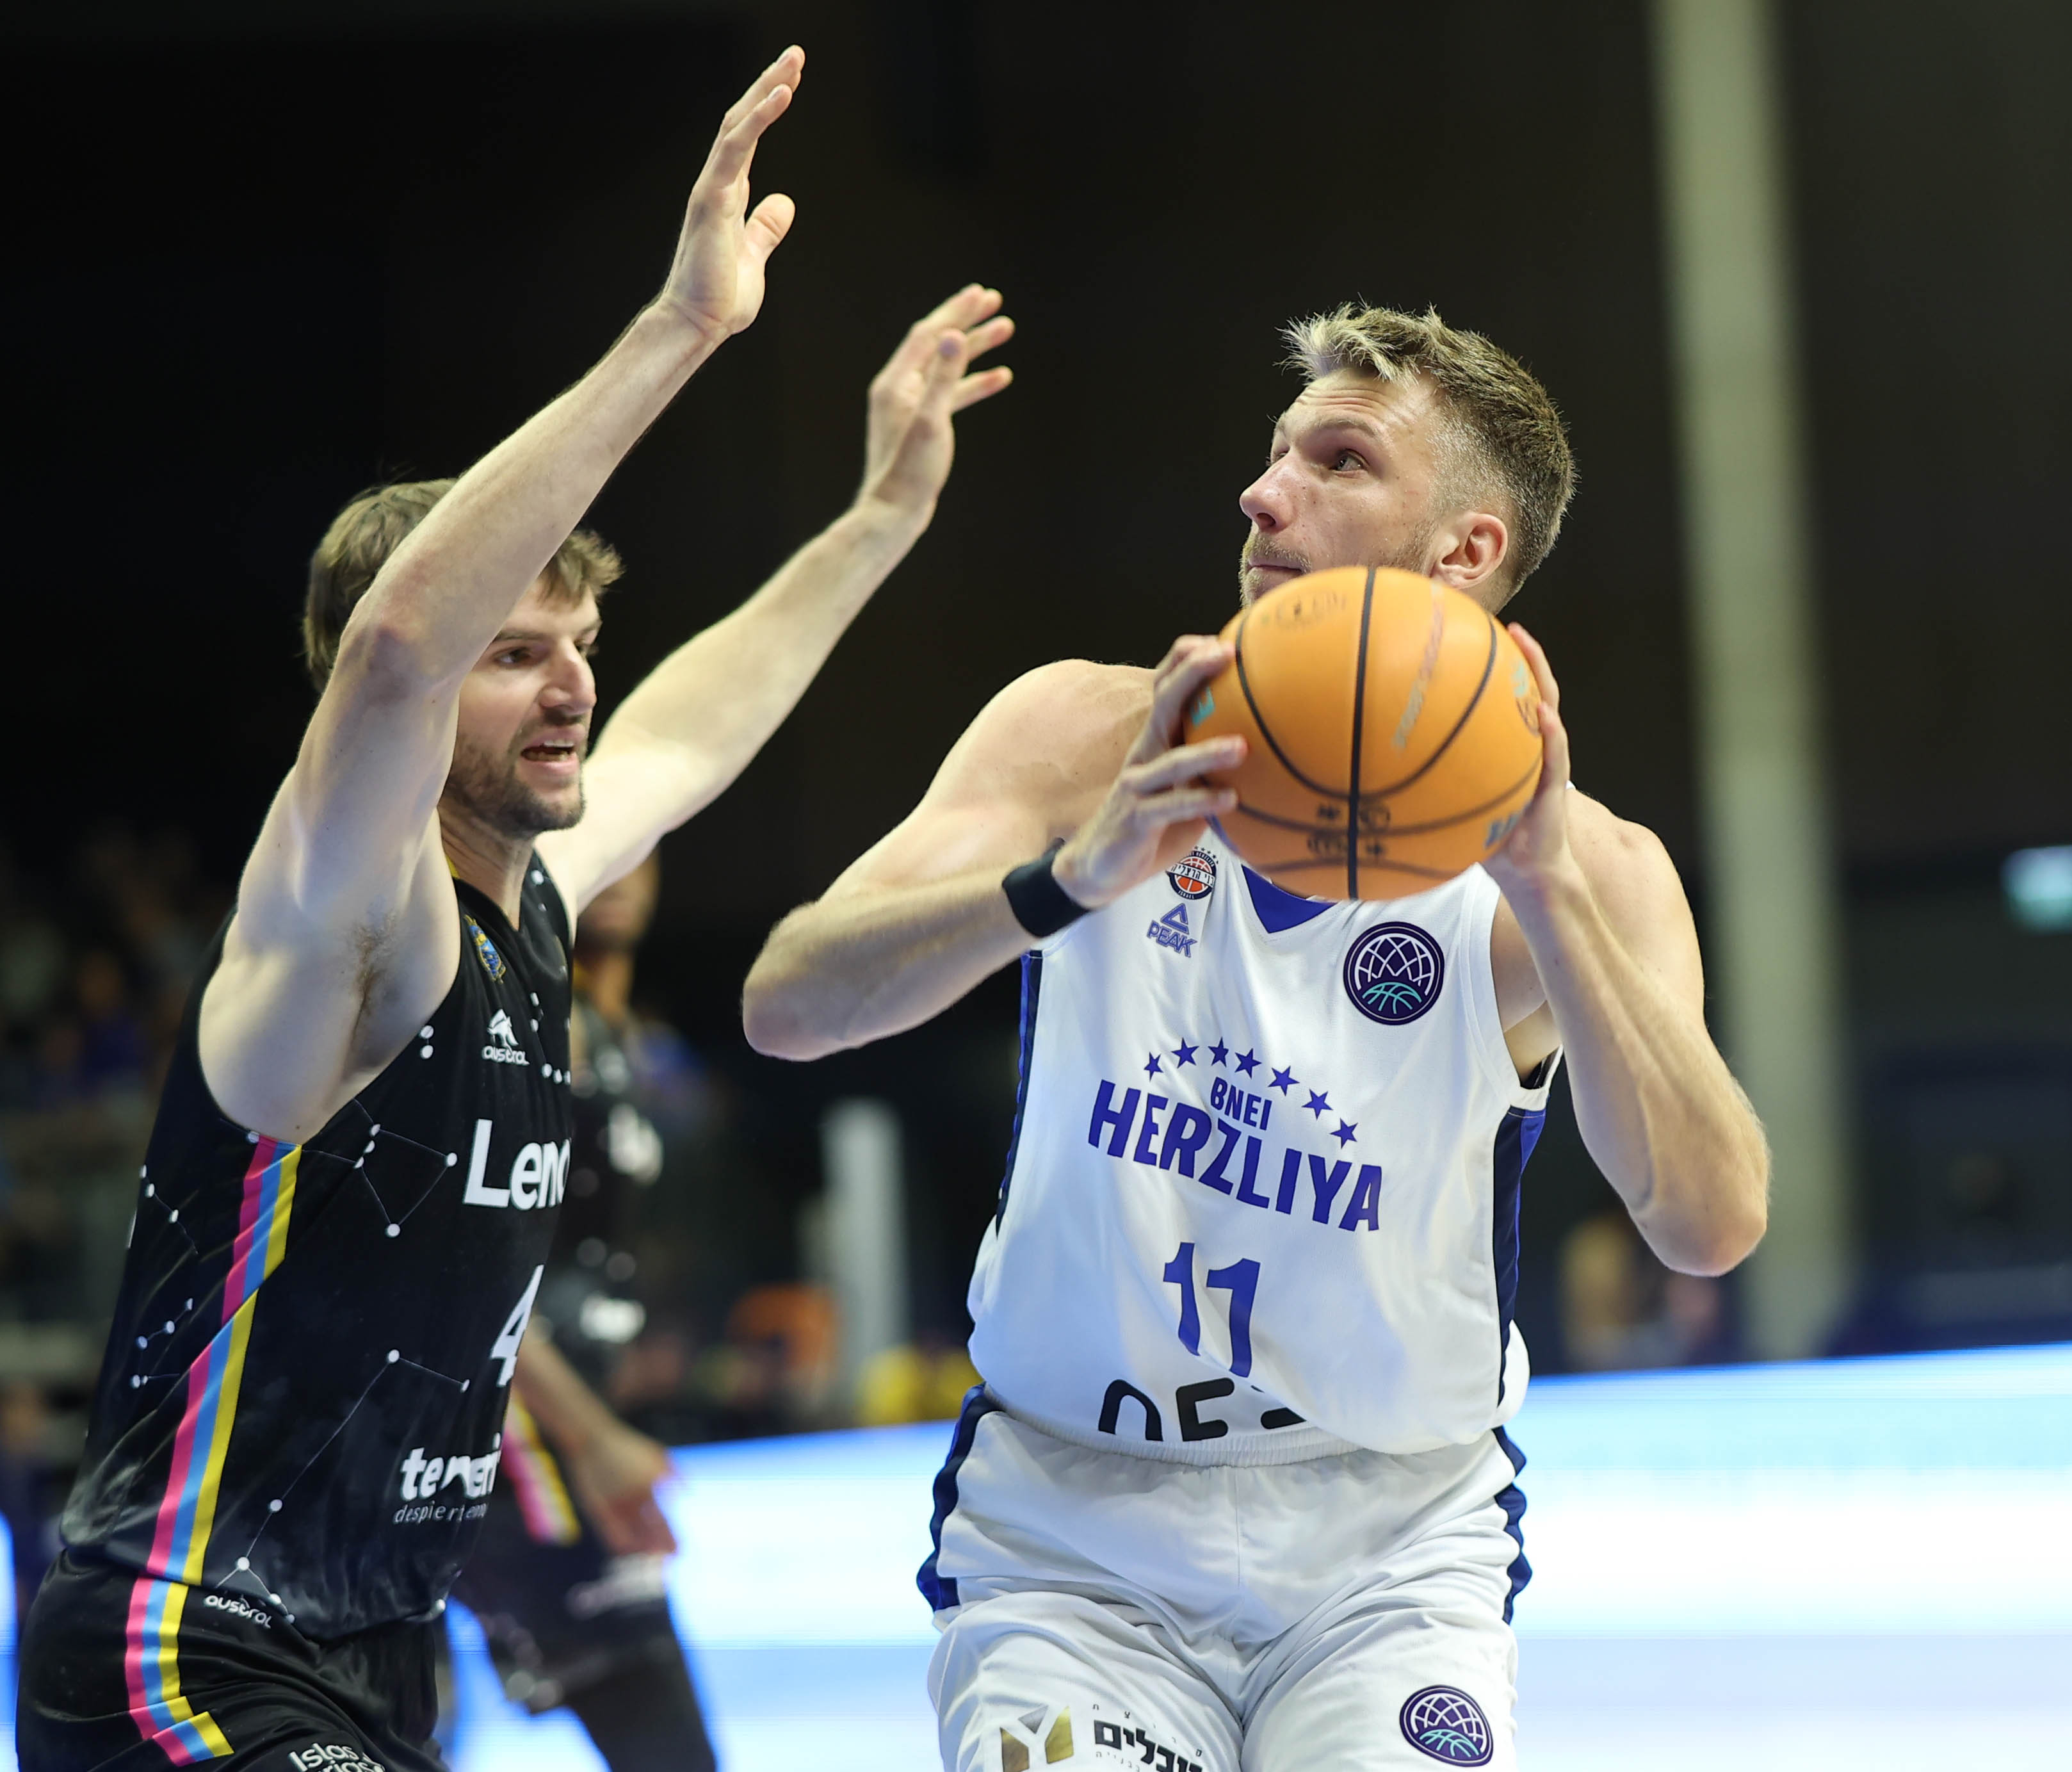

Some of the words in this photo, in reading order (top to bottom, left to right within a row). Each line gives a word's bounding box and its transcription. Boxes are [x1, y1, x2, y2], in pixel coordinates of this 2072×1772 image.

[1147, 920, 1198, 958] PEAK
[1211, 1077, 1274, 1131] BNEI
[1088, 1079, 1382, 1231] HERZLIYA
[1163, 1242, 1261, 1378] 11
[204, 1595, 271, 1629] austral
[289, 1743, 360, 1772] Islas
